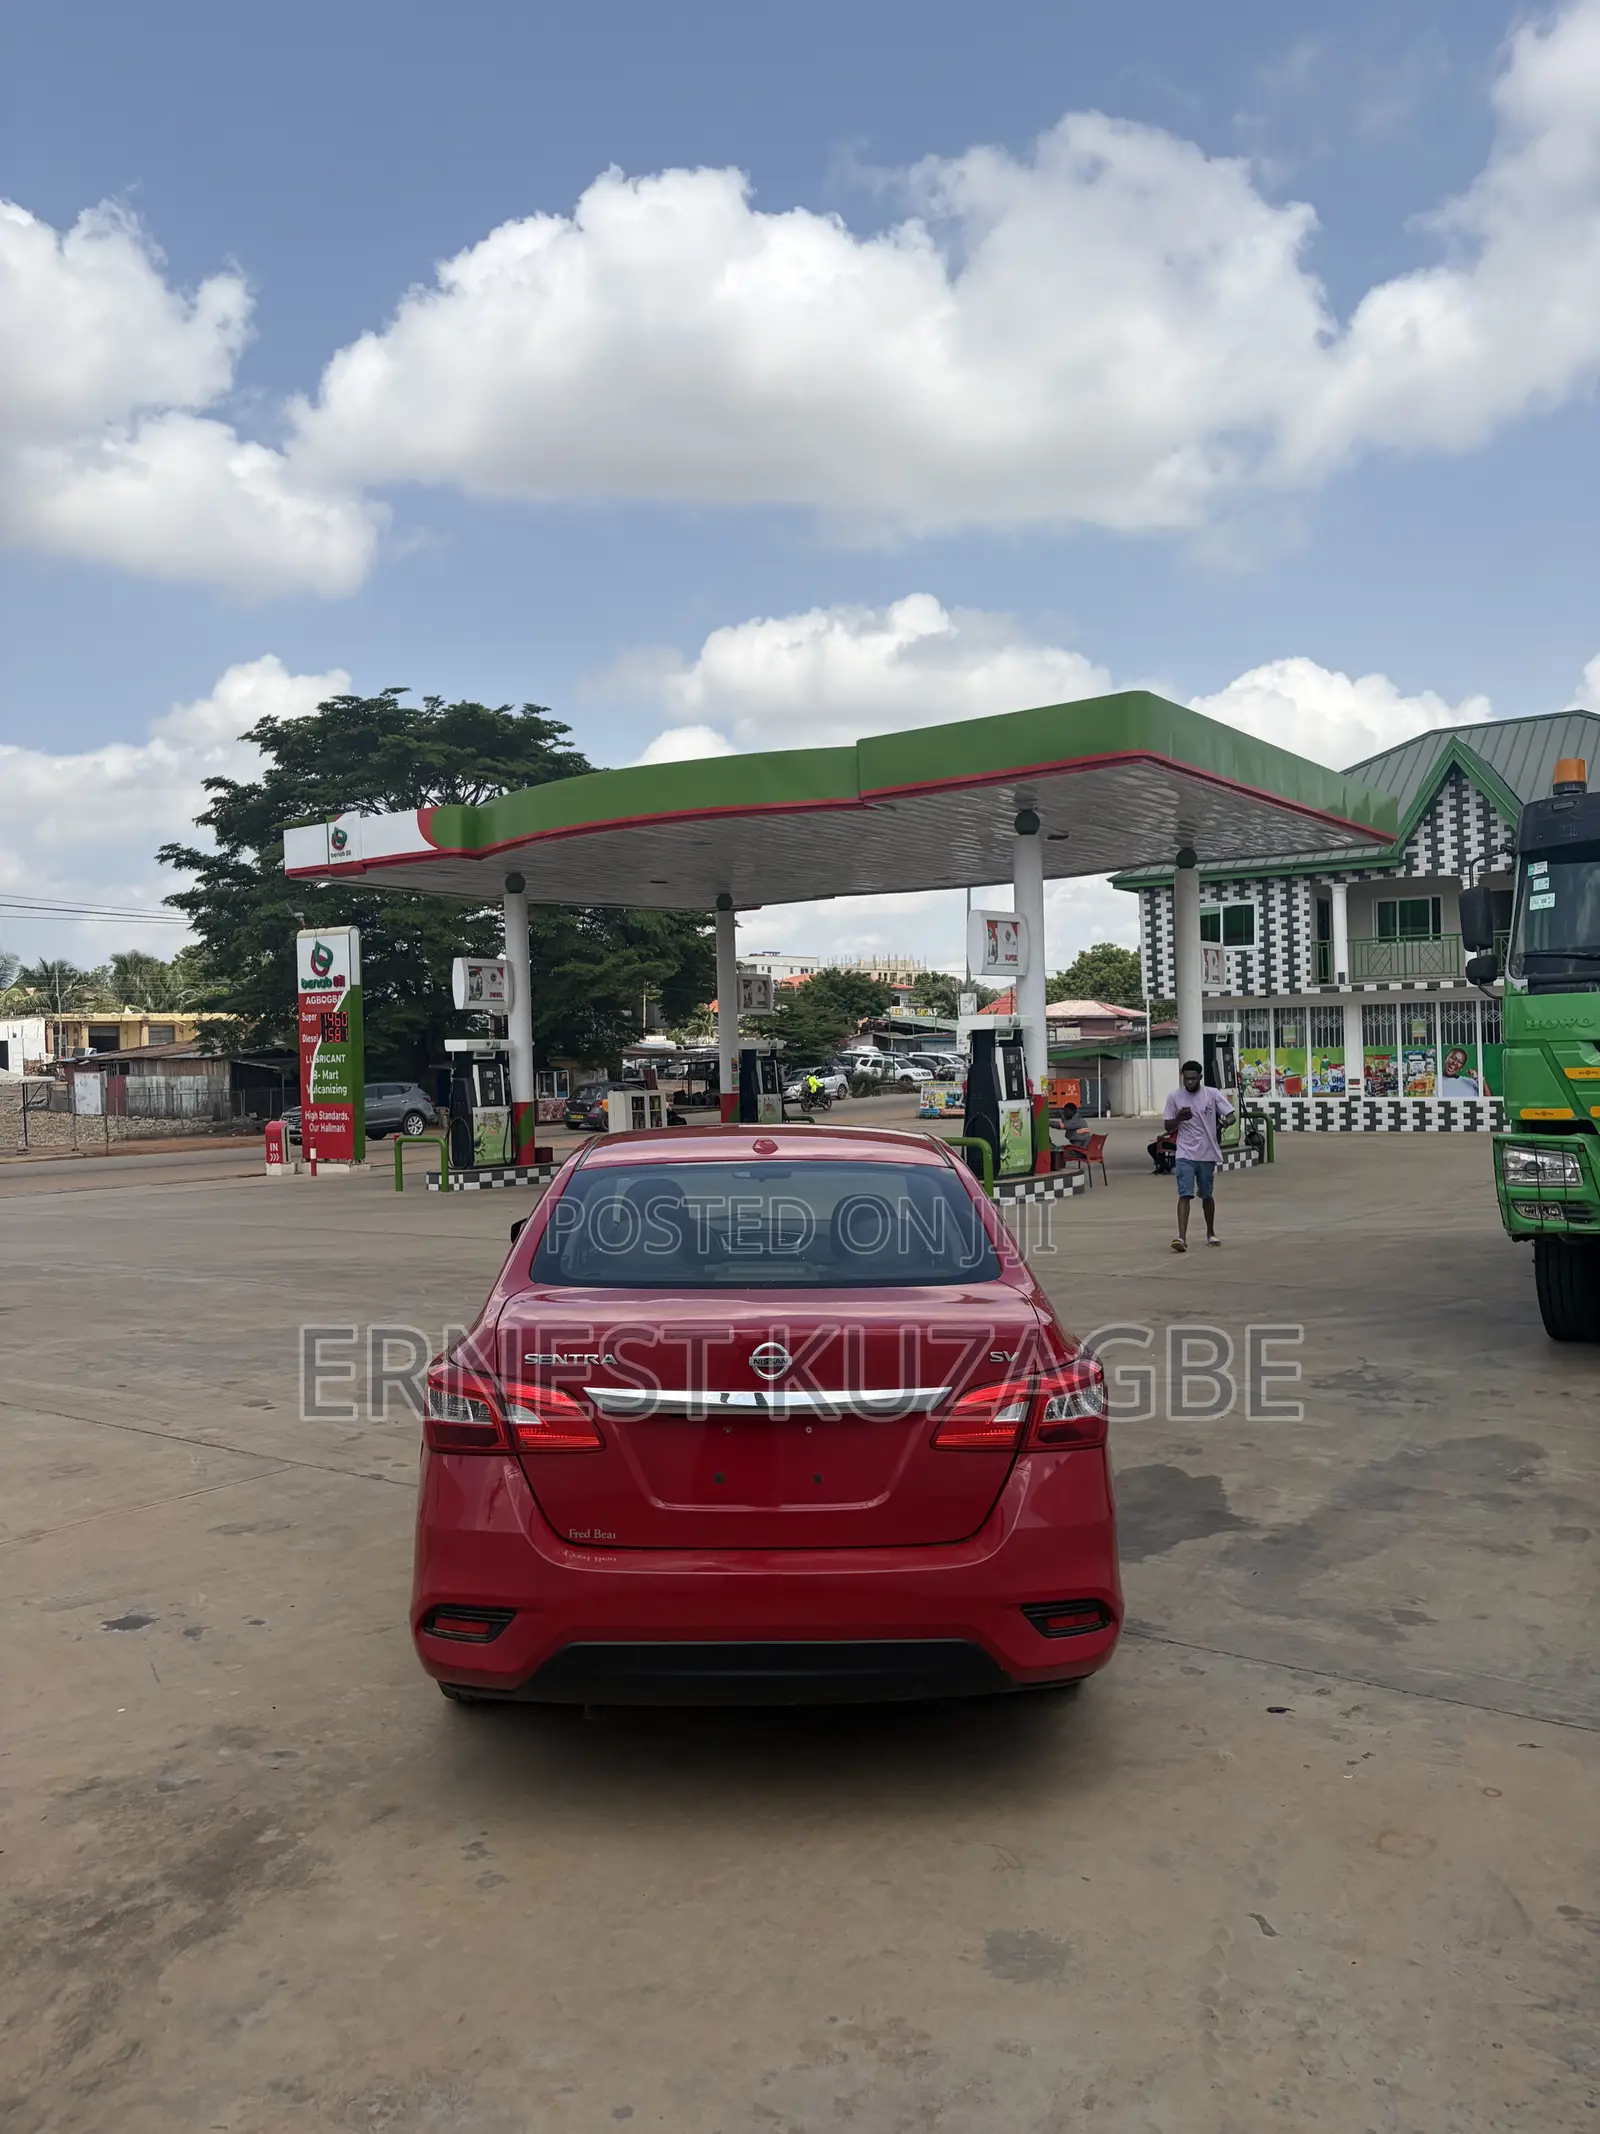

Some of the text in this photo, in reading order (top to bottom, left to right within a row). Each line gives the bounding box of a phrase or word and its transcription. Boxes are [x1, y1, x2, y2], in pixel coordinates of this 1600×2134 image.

[301, 977, 332, 989] benab
[301, 1012, 317, 1023] Super
[1524, 1018, 1596, 1031] HOWO
[302, 1034, 319, 1043] Diesel
[305, 1054, 346, 1063] LUBRICANT
[322, 1070, 339, 1080] Mart
[304, 1110, 350, 1121] High Standards,
[309, 1123, 346, 1132] Our Hallmark
[270, 1143, 278, 1151] IN
[523, 1353, 618, 1365] SENTRA
[989, 1351, 1020, 1363] SV
[568, 1528, 591, 1539] Fred
